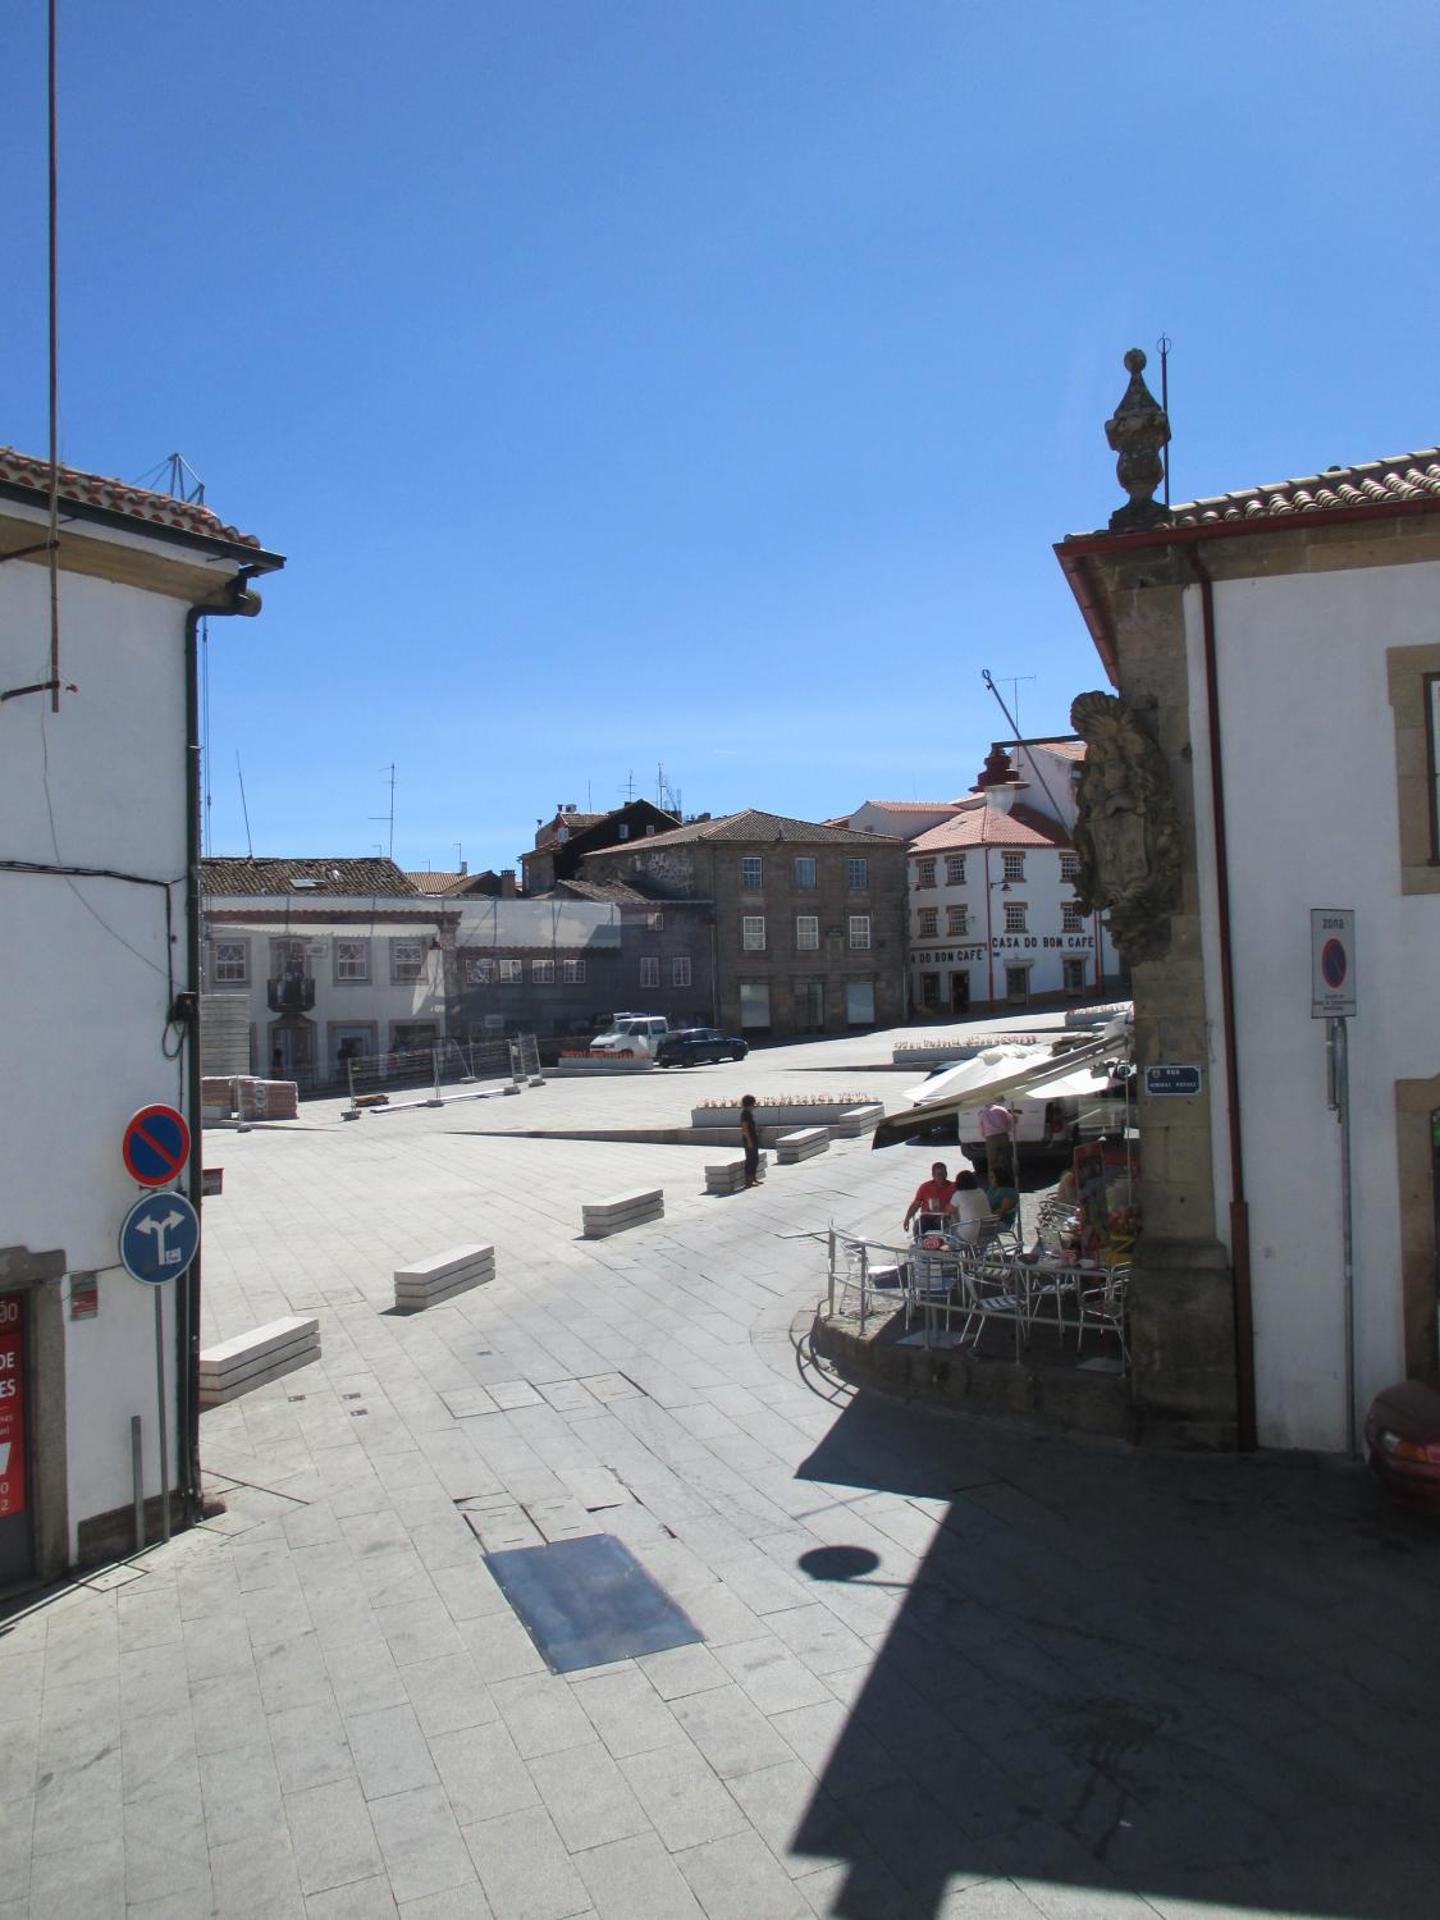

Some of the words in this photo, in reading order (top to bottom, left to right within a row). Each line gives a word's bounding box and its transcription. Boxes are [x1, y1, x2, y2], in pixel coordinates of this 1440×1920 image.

[991, 936, 1020, 948] CASA
[1024, 936, 1038, 948] DO
[1043, 936, 1063, 948] BOM
[919, 952, 931, 963] DO
[935, 951, 954, 962] BOM
